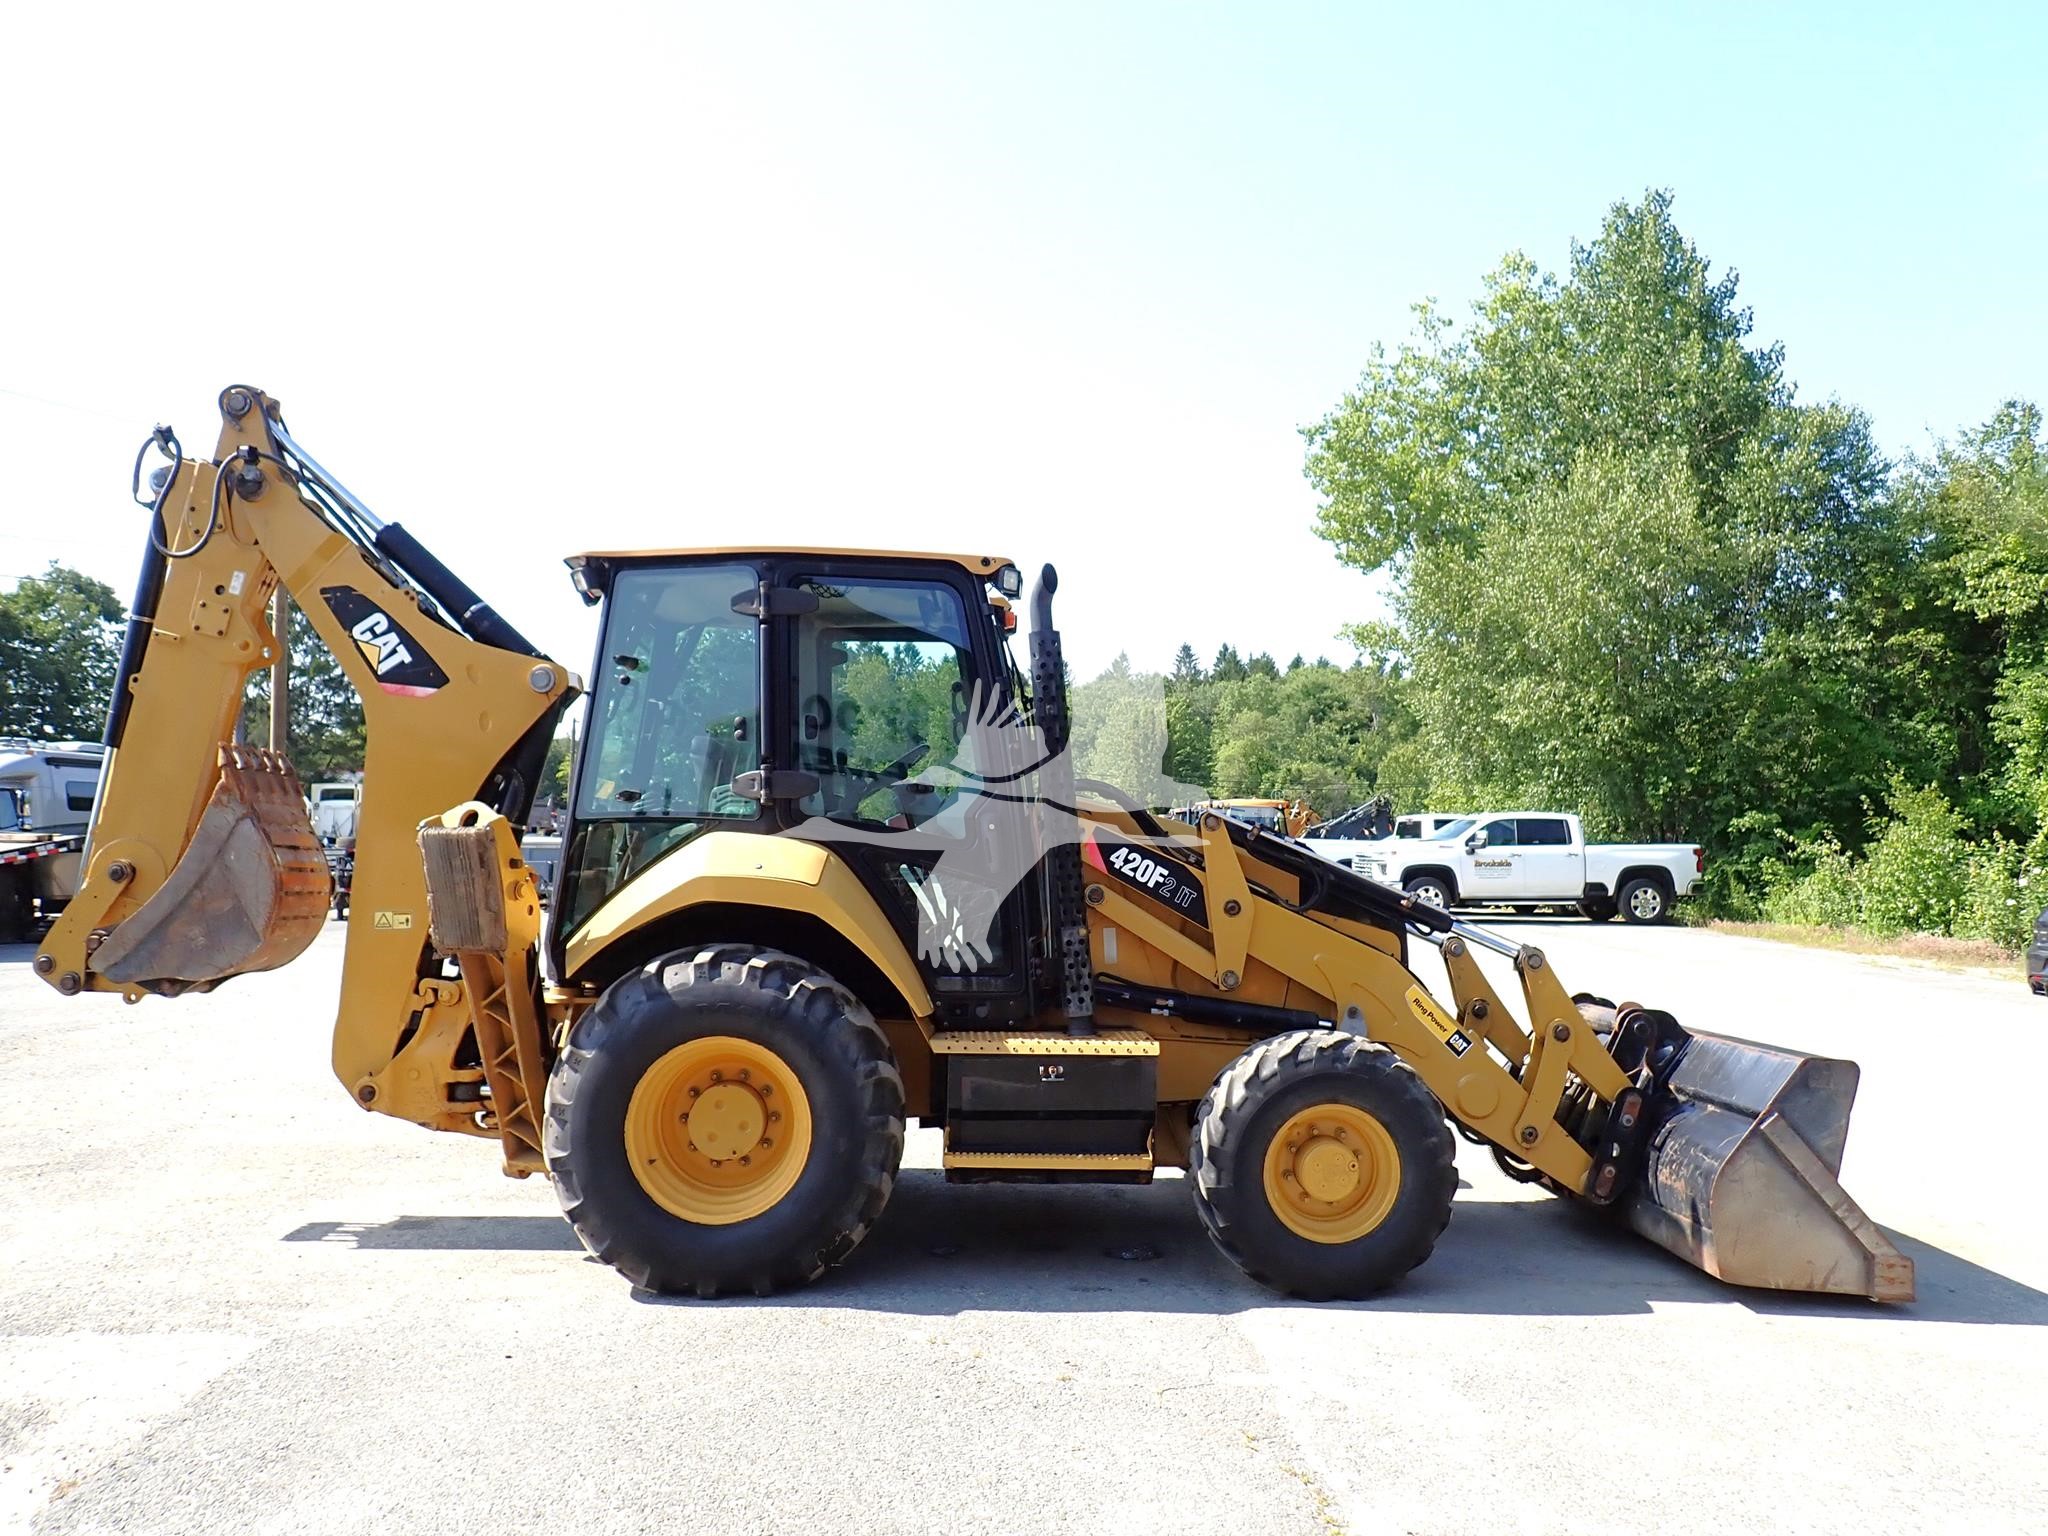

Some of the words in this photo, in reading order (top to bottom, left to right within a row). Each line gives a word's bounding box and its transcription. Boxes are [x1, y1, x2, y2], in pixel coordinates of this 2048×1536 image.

[352, 612, 412, 675] CAT
[1175, 886, 1197, 907] IT
[1413, 998, 1428, 1015] Ring
[1427, 1011, 1448, 1033] Power
[1449, 1034, 1468, 1052] CAT
